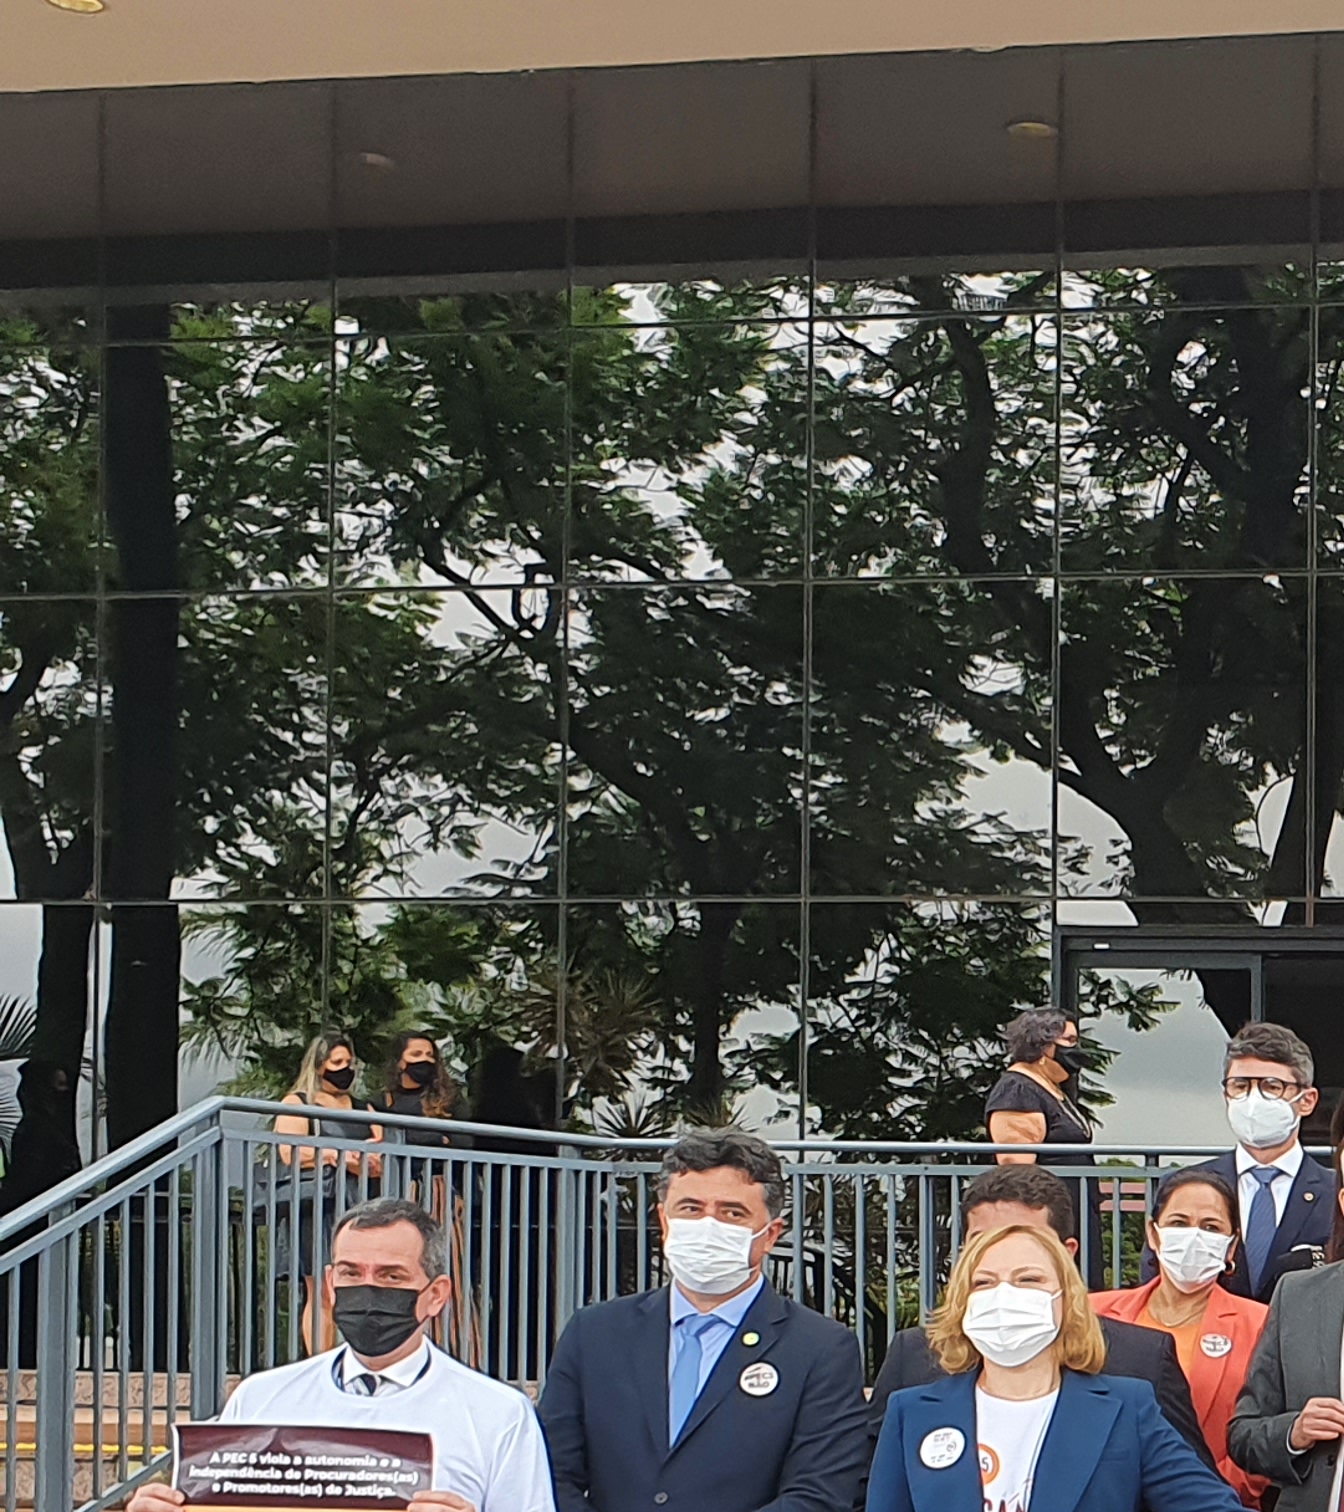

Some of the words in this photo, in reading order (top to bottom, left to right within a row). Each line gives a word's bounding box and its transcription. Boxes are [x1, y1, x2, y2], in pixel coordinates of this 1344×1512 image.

[209, 1452, 220, 1463] A
[223, 1453, 247, 1463] PEC
[260, 1453, 291, 1465] viola
[305, 1456, 377, 1466] autonomia
